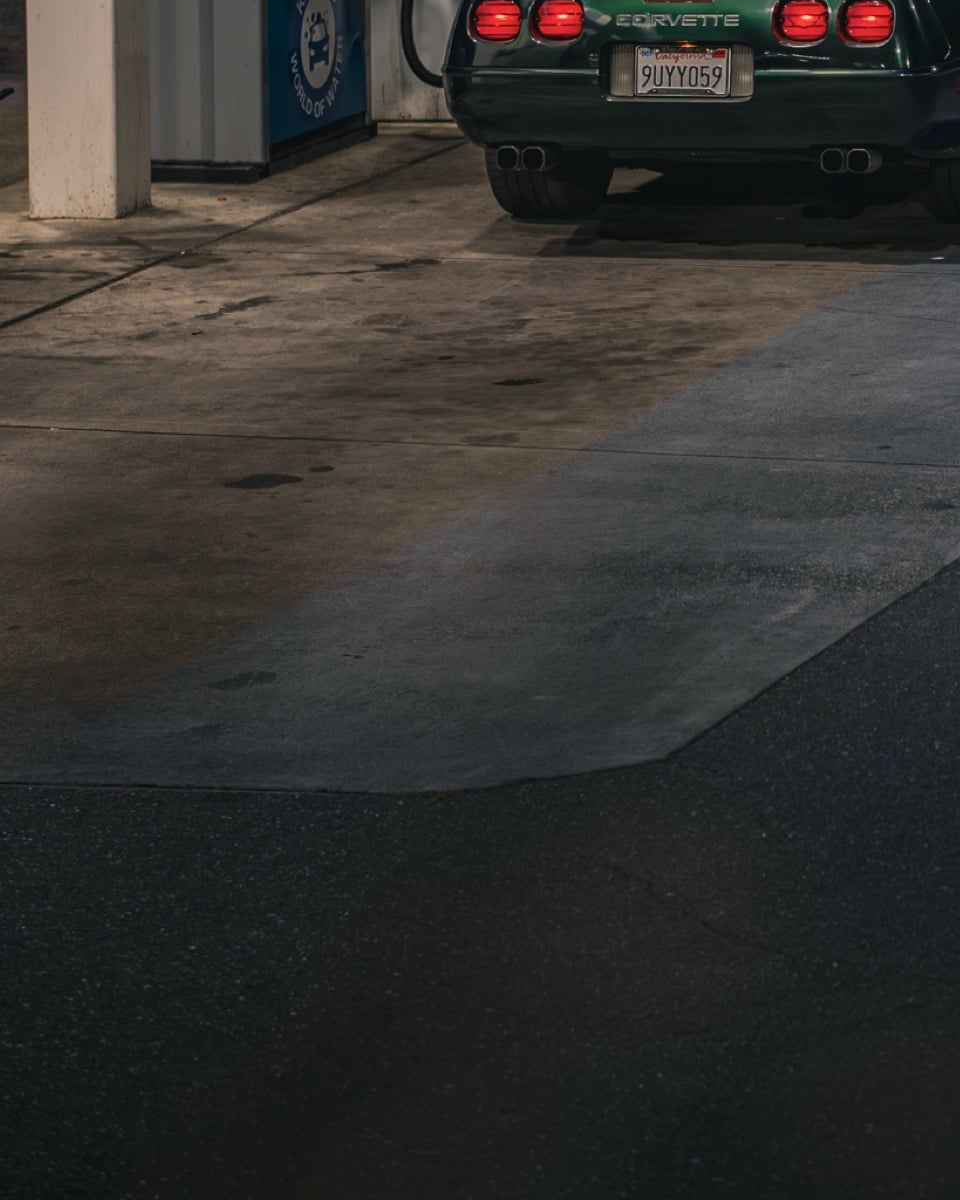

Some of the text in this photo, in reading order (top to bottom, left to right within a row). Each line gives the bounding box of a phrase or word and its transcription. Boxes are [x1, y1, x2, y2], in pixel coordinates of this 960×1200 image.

[616, 13, 740, 27] CORVETTE
[290, 35, 344, 118] WORLD OF WATER
[641, 65, 723, 89] 9UYY059
